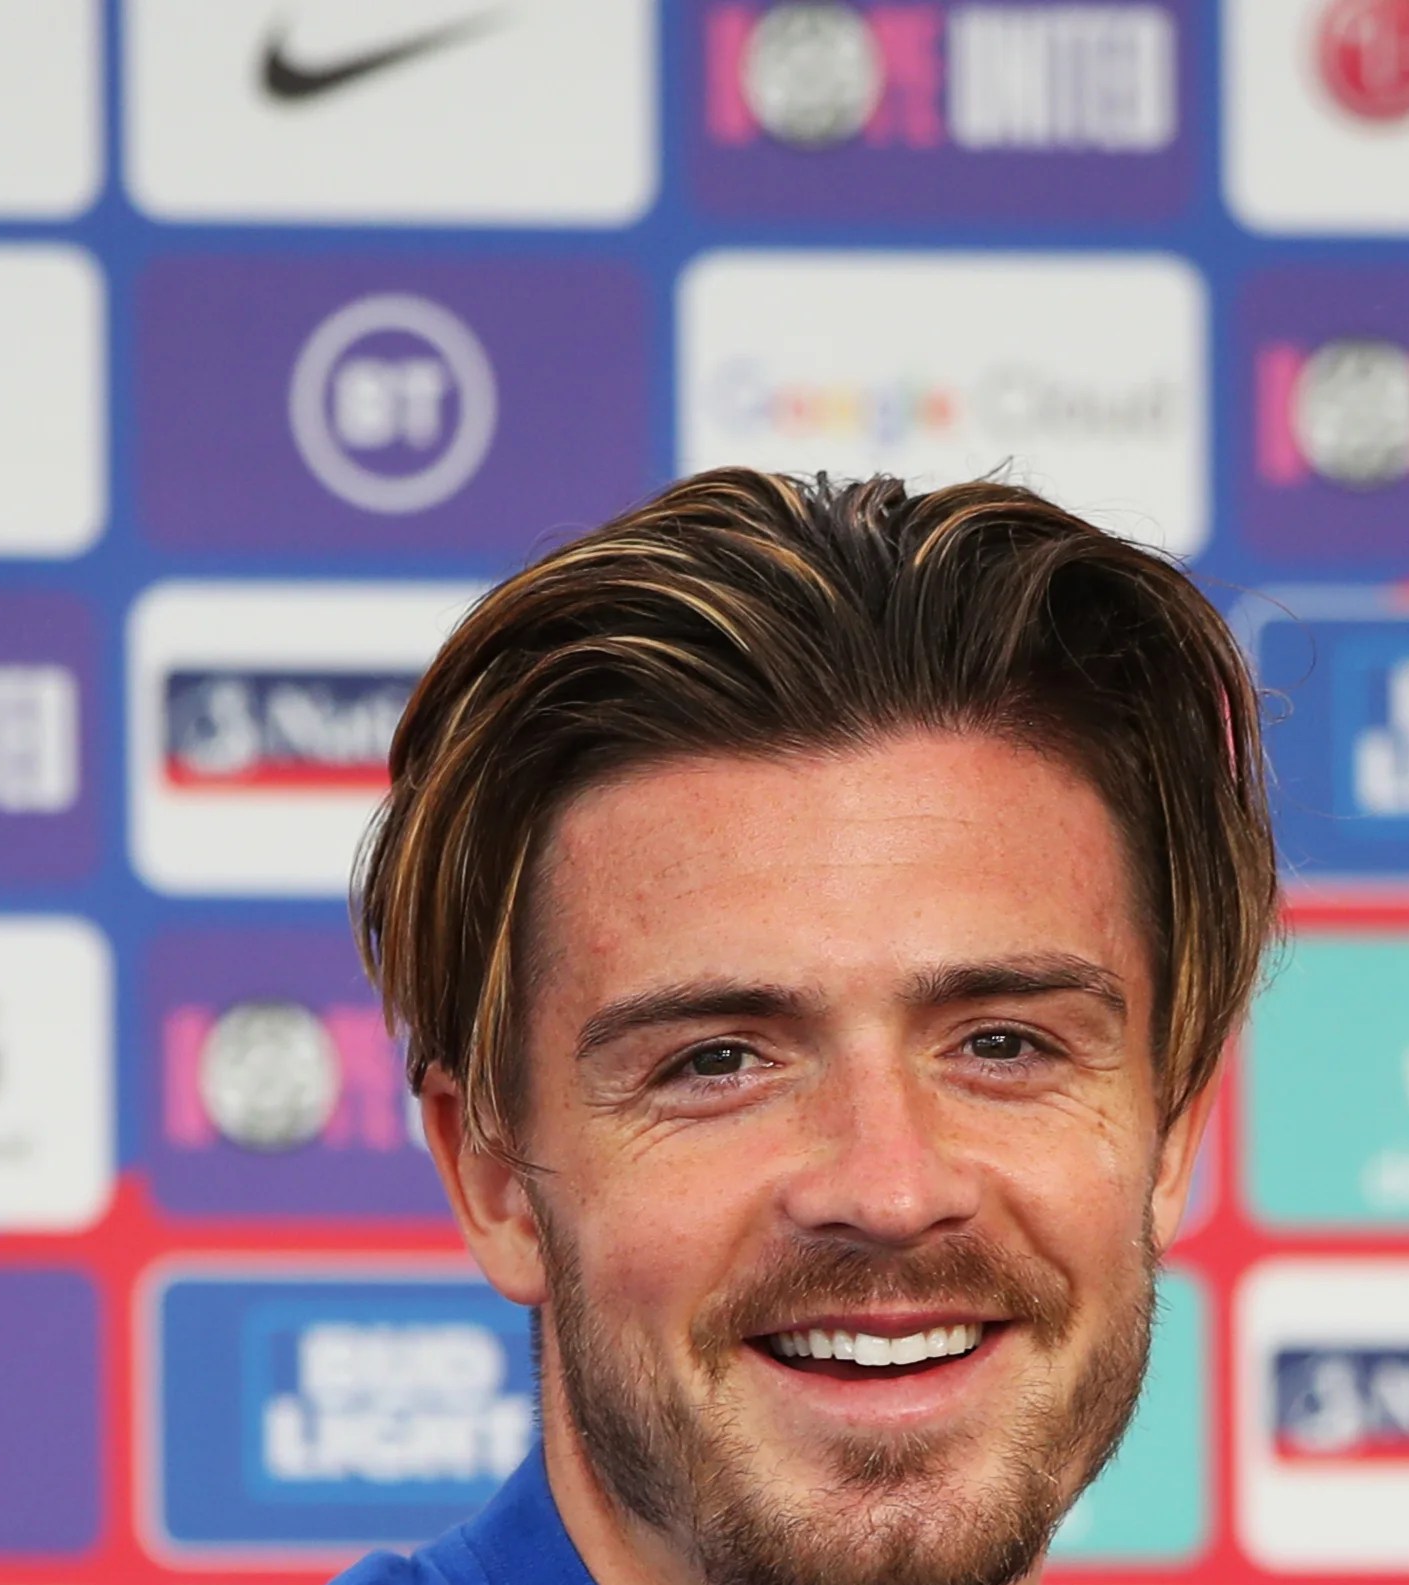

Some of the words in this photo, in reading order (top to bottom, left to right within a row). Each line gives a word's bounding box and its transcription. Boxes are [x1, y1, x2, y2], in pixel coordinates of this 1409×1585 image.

[950, 8, 1176, 150] UNITED
[332, 356, 450, 449] BT
[709, 356, 960, 442] Google
[978, 356, 1172, 437] Cloud
[298, 1323, 506, 1392] BUD
[263, 1393, 532, 1482] LIGHT
